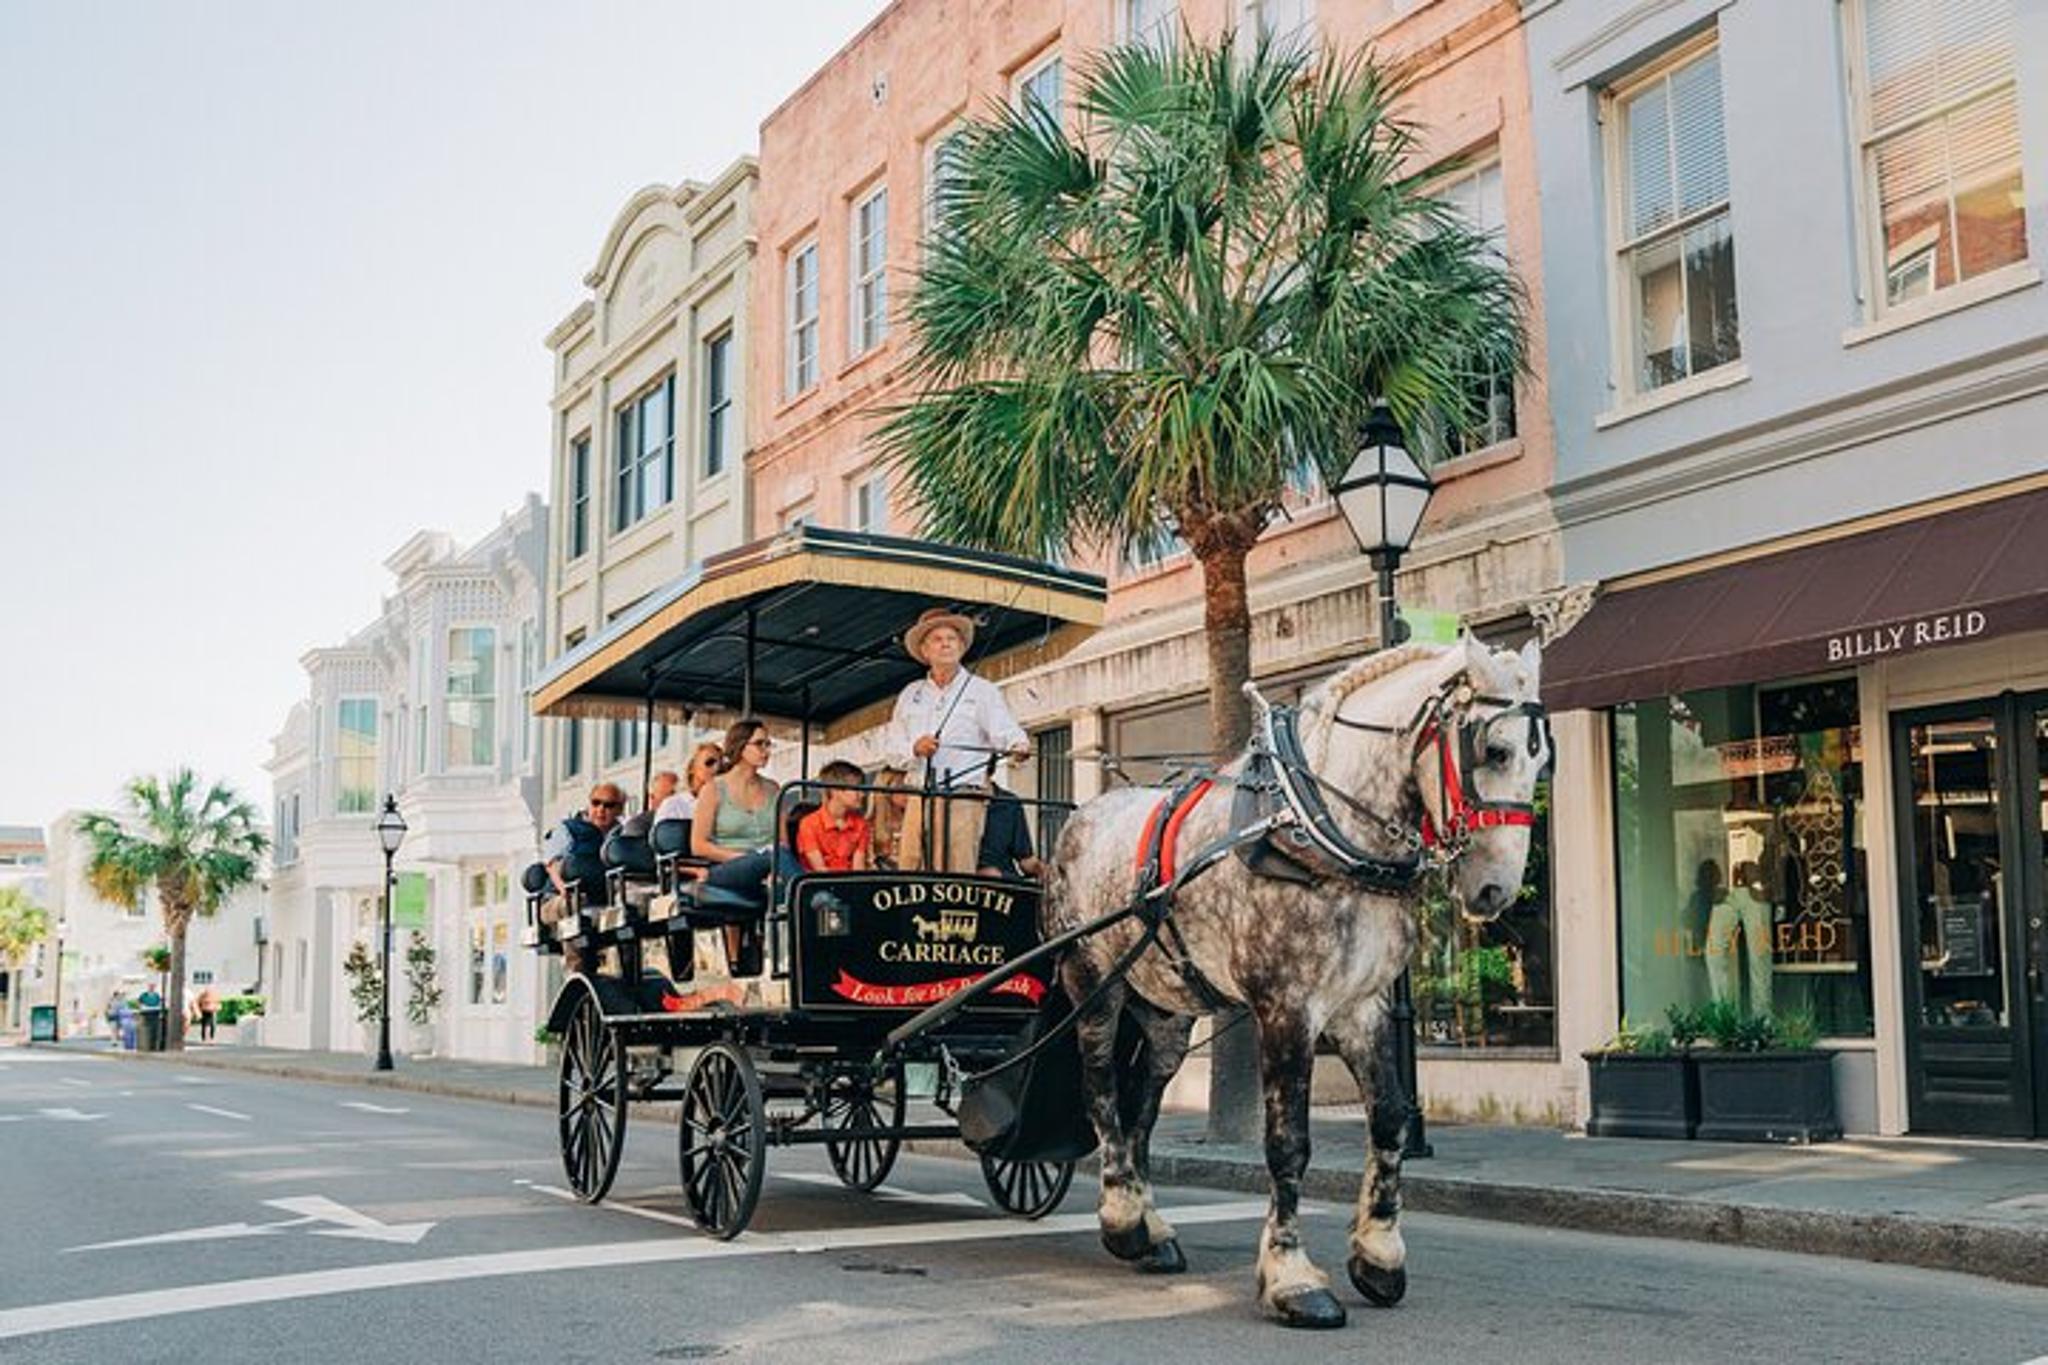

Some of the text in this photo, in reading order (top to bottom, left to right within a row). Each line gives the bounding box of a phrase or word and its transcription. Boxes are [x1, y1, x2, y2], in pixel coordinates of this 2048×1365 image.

[1828, 610, 1986, 661] BILLY REID
[872, 883, 1014, 914] OLD SOUTH
[879, 940, 1005, 964] CARRIAGE
[852, 984, 894, 1003] Look
[903, 986, 924, 1003] for
[929, 983, 957, 998] the
